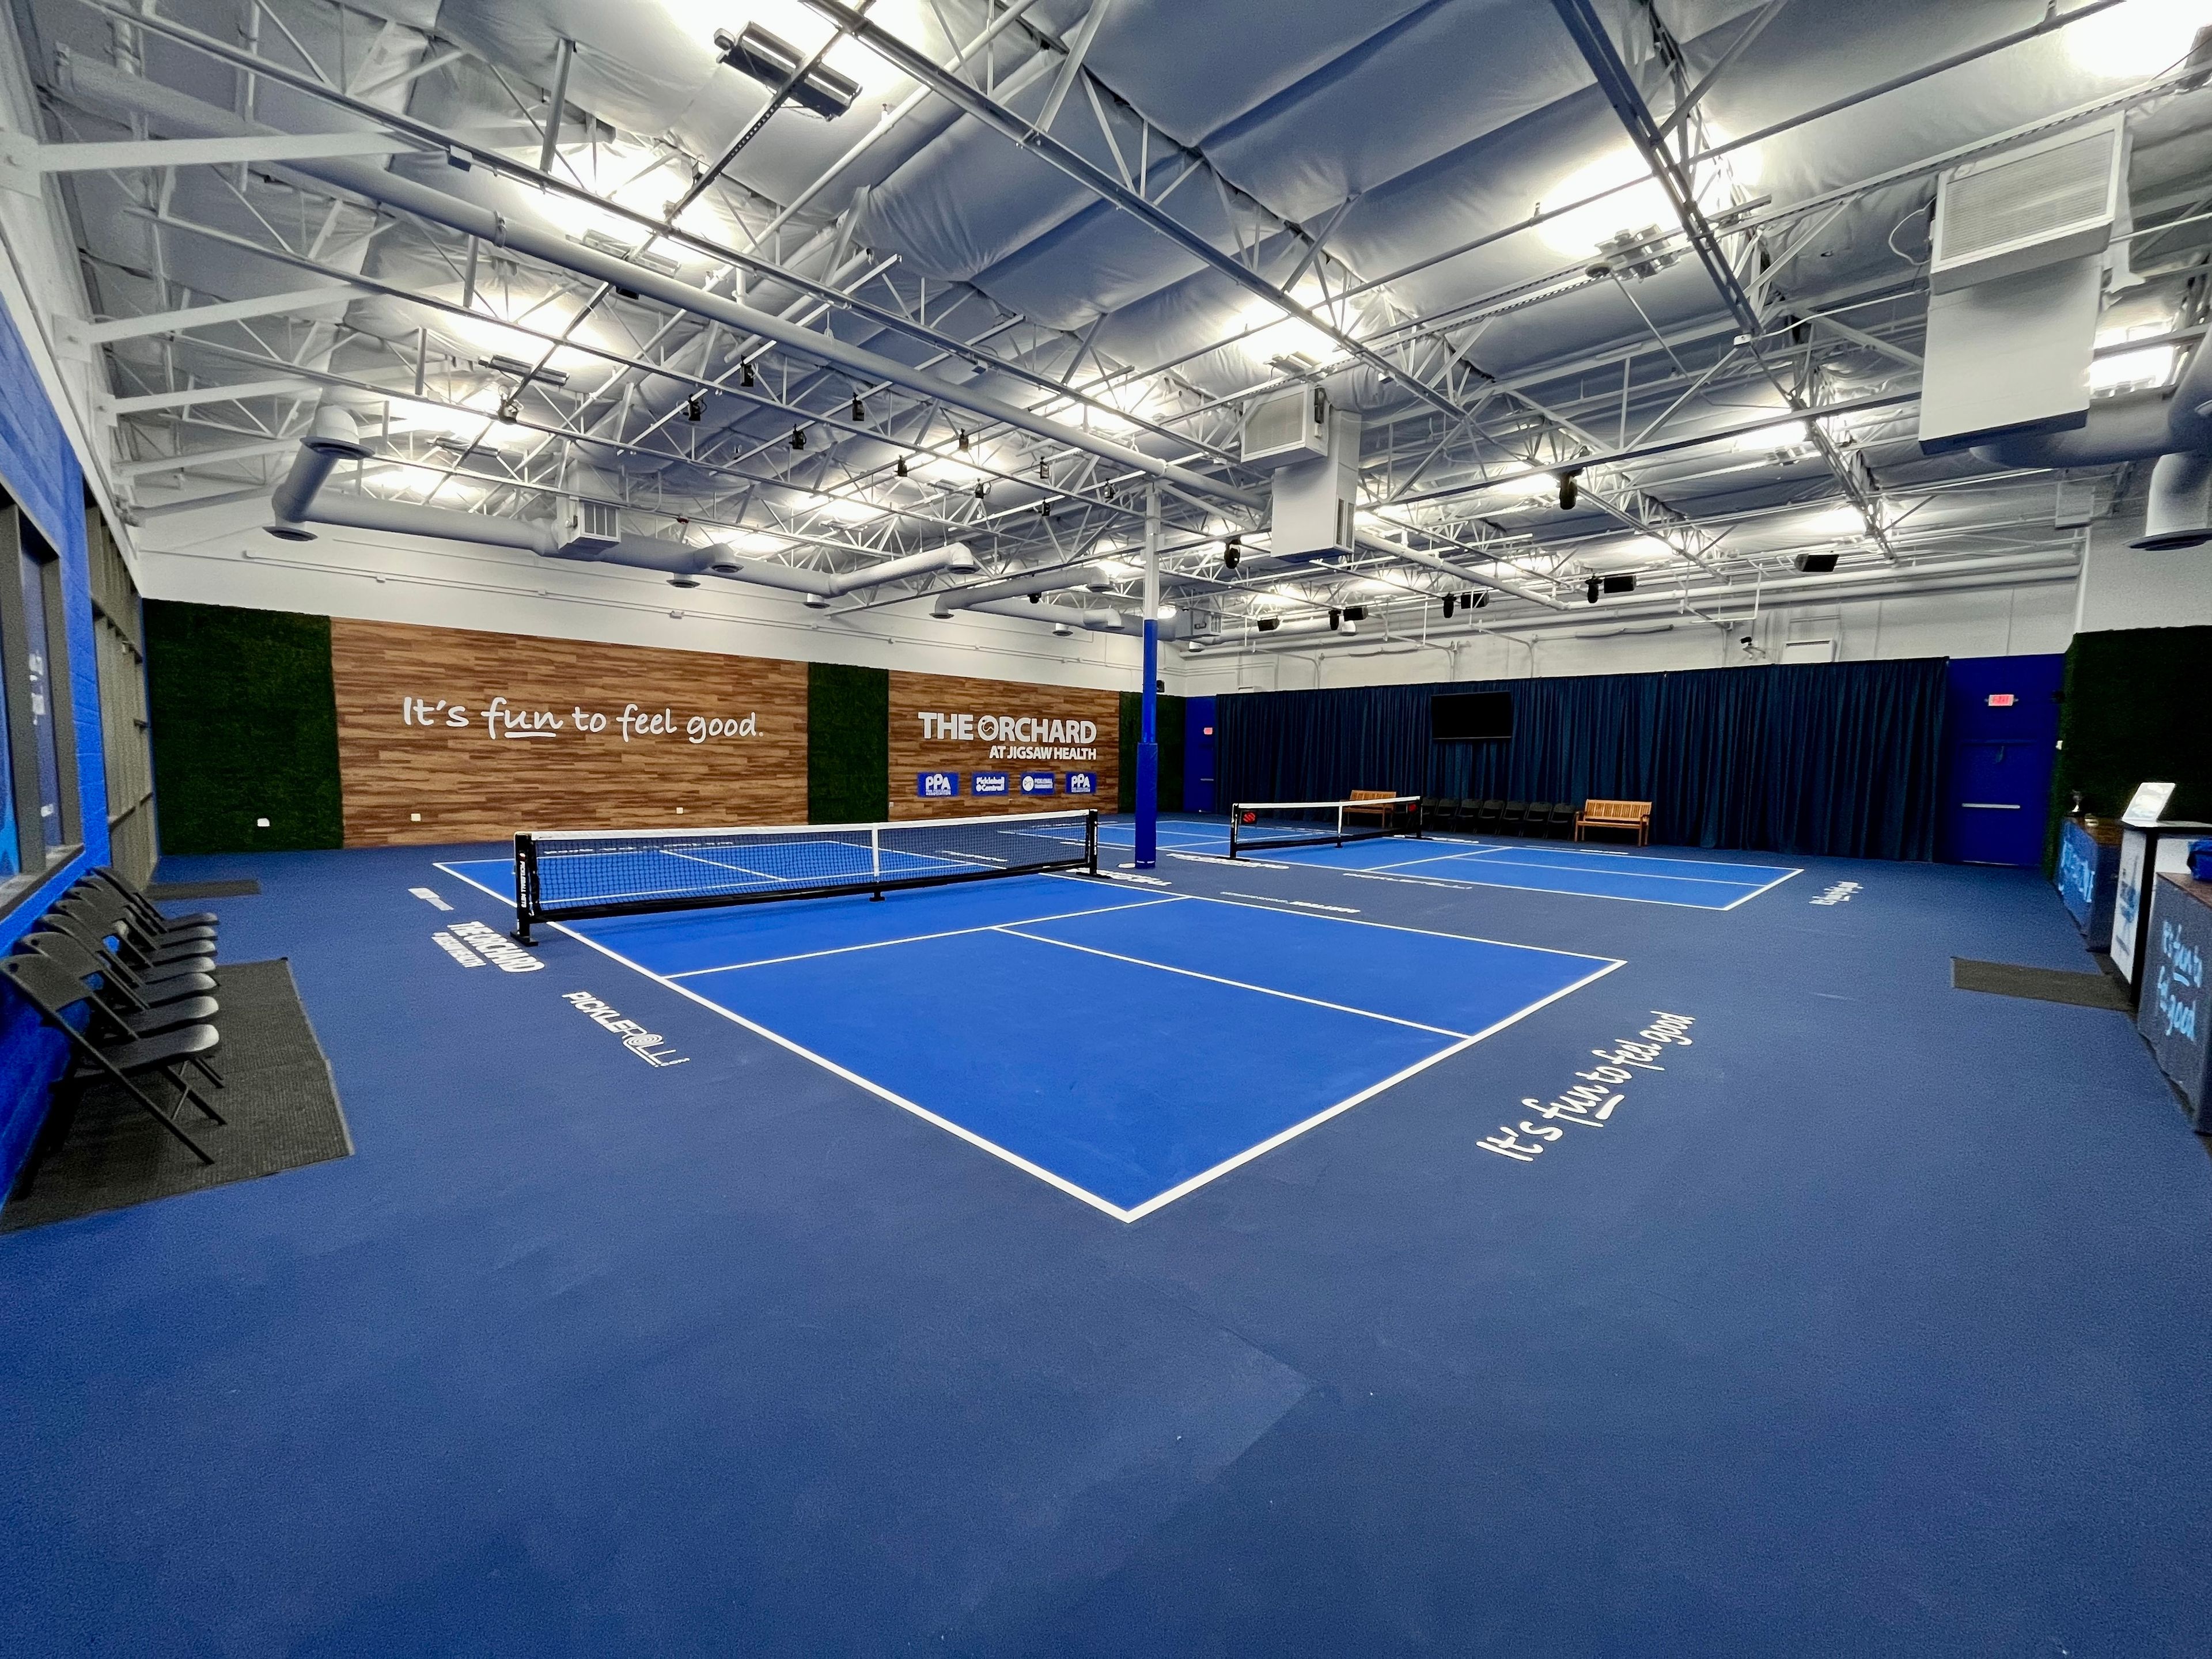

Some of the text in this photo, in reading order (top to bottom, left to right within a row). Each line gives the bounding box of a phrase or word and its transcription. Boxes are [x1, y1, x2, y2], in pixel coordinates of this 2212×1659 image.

[403, 696, 764, 744] It's fun to feel good.
[918, 711, 1097, 744] THE ORCHARD
[989, 745, 1097, 760] AT JIGSAW HEALTH
[925, 774, 951, 790] PPA
[1071, 774, 1090, 787] PPA
[446, 921, 495, 937] THE
[463, 933, 546, 973] ORCHARD
[1476, 1010, 1696, 1161] It's fun to feel good
